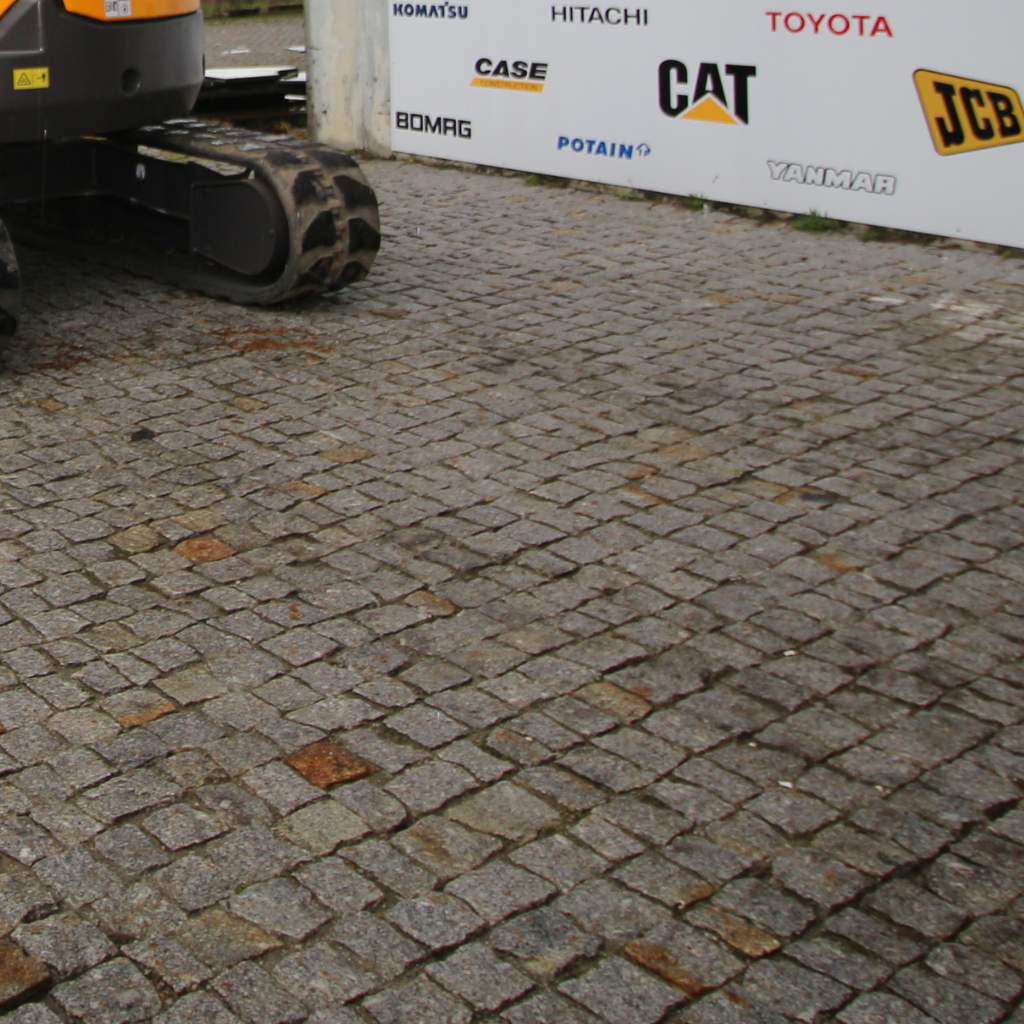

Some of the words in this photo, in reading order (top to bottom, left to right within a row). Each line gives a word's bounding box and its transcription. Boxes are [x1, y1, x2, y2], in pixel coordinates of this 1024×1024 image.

[393, 1, 468, 19] KOMATSU
[551, 6, 648, 26] HITACHI
[765, 11, 893, 38] TOYOTA
[475, 58, 548, 80] CASE
[478, 79, 539, 91] CONSTRUCTION
[658, 59, 757, 125] CAT
[396, 112, 471, 139] BOMAG
[932, 81, 1021, 148] JCB
[557, 136, 633, 159] POTAIN
[766, 160, 896, 196] YANMAR
